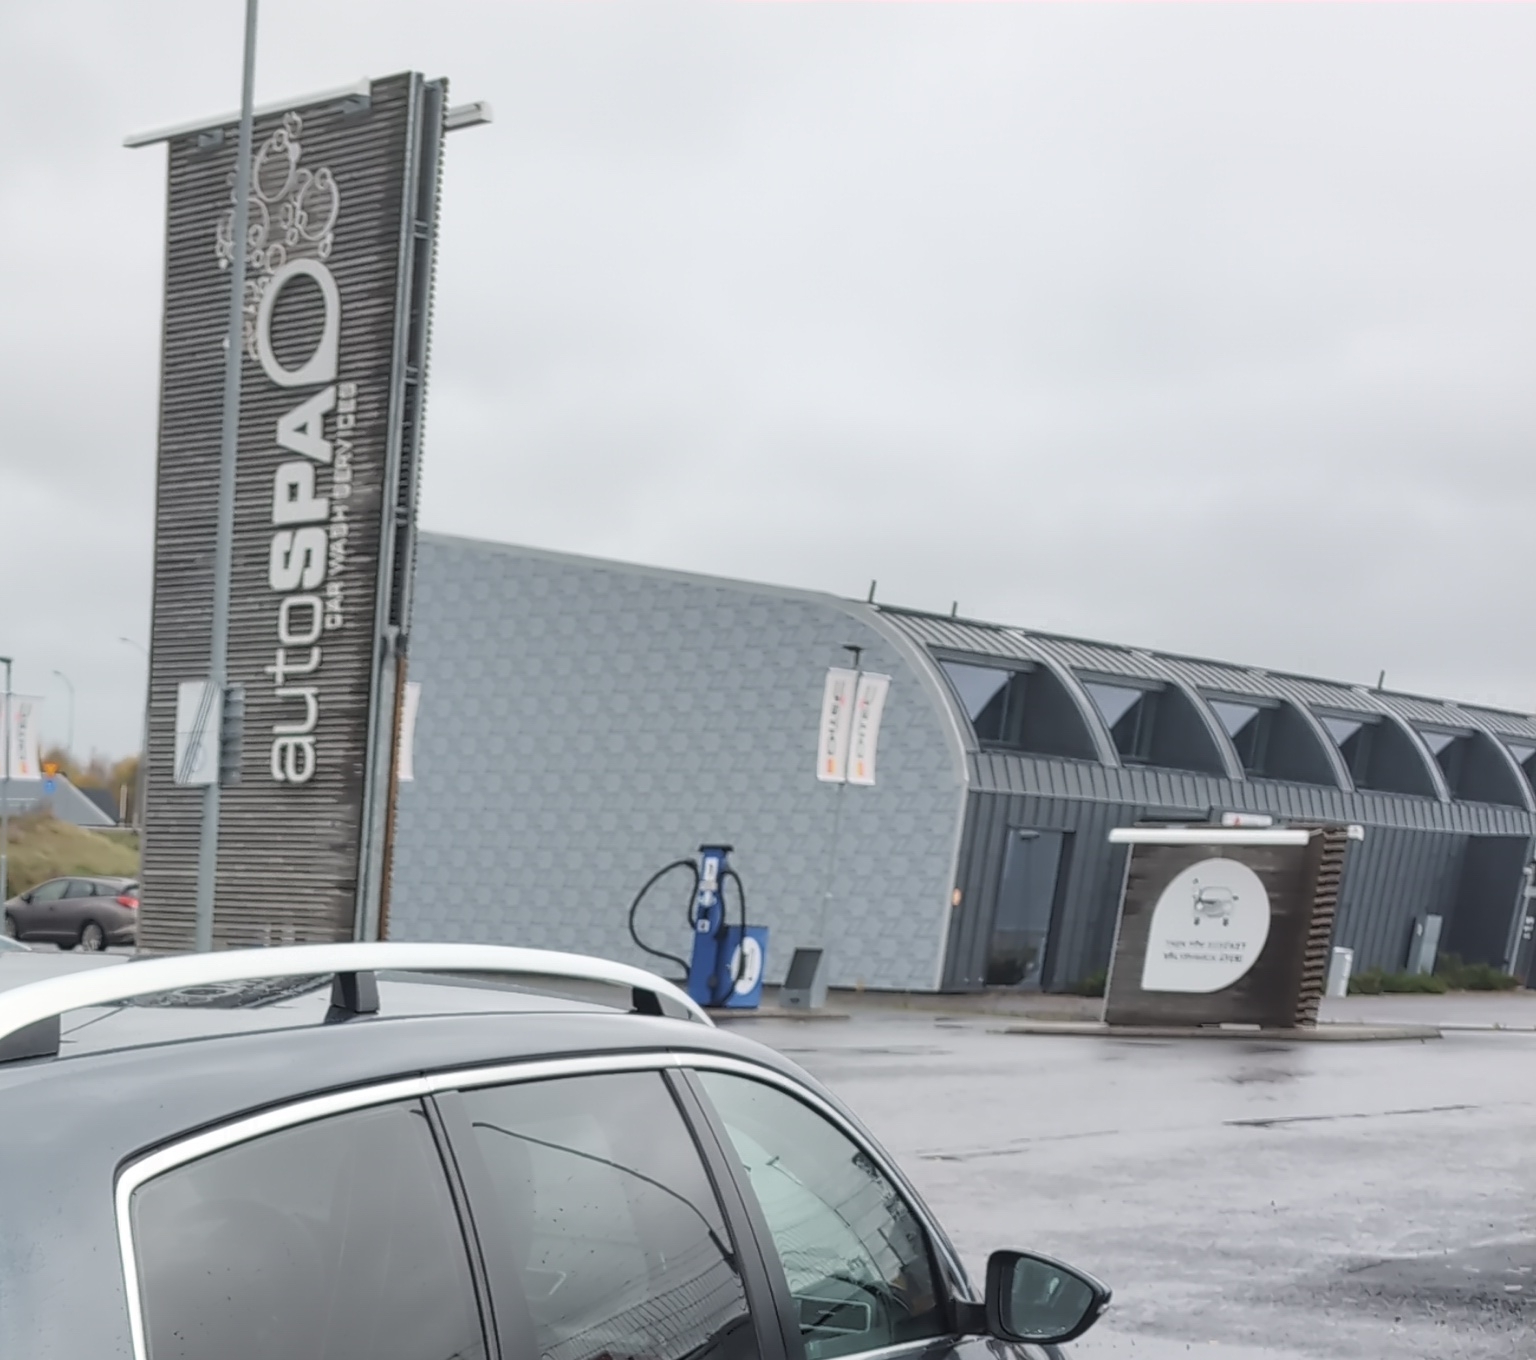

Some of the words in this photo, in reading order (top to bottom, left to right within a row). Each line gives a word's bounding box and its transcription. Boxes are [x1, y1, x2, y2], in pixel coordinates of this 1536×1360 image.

[332, 382, 358, 499] SERVICES
[265, 385, 338, 784] autoSPA
[328, 504, 350, 577] WASH
[324, 581, 344, 630] CAR
